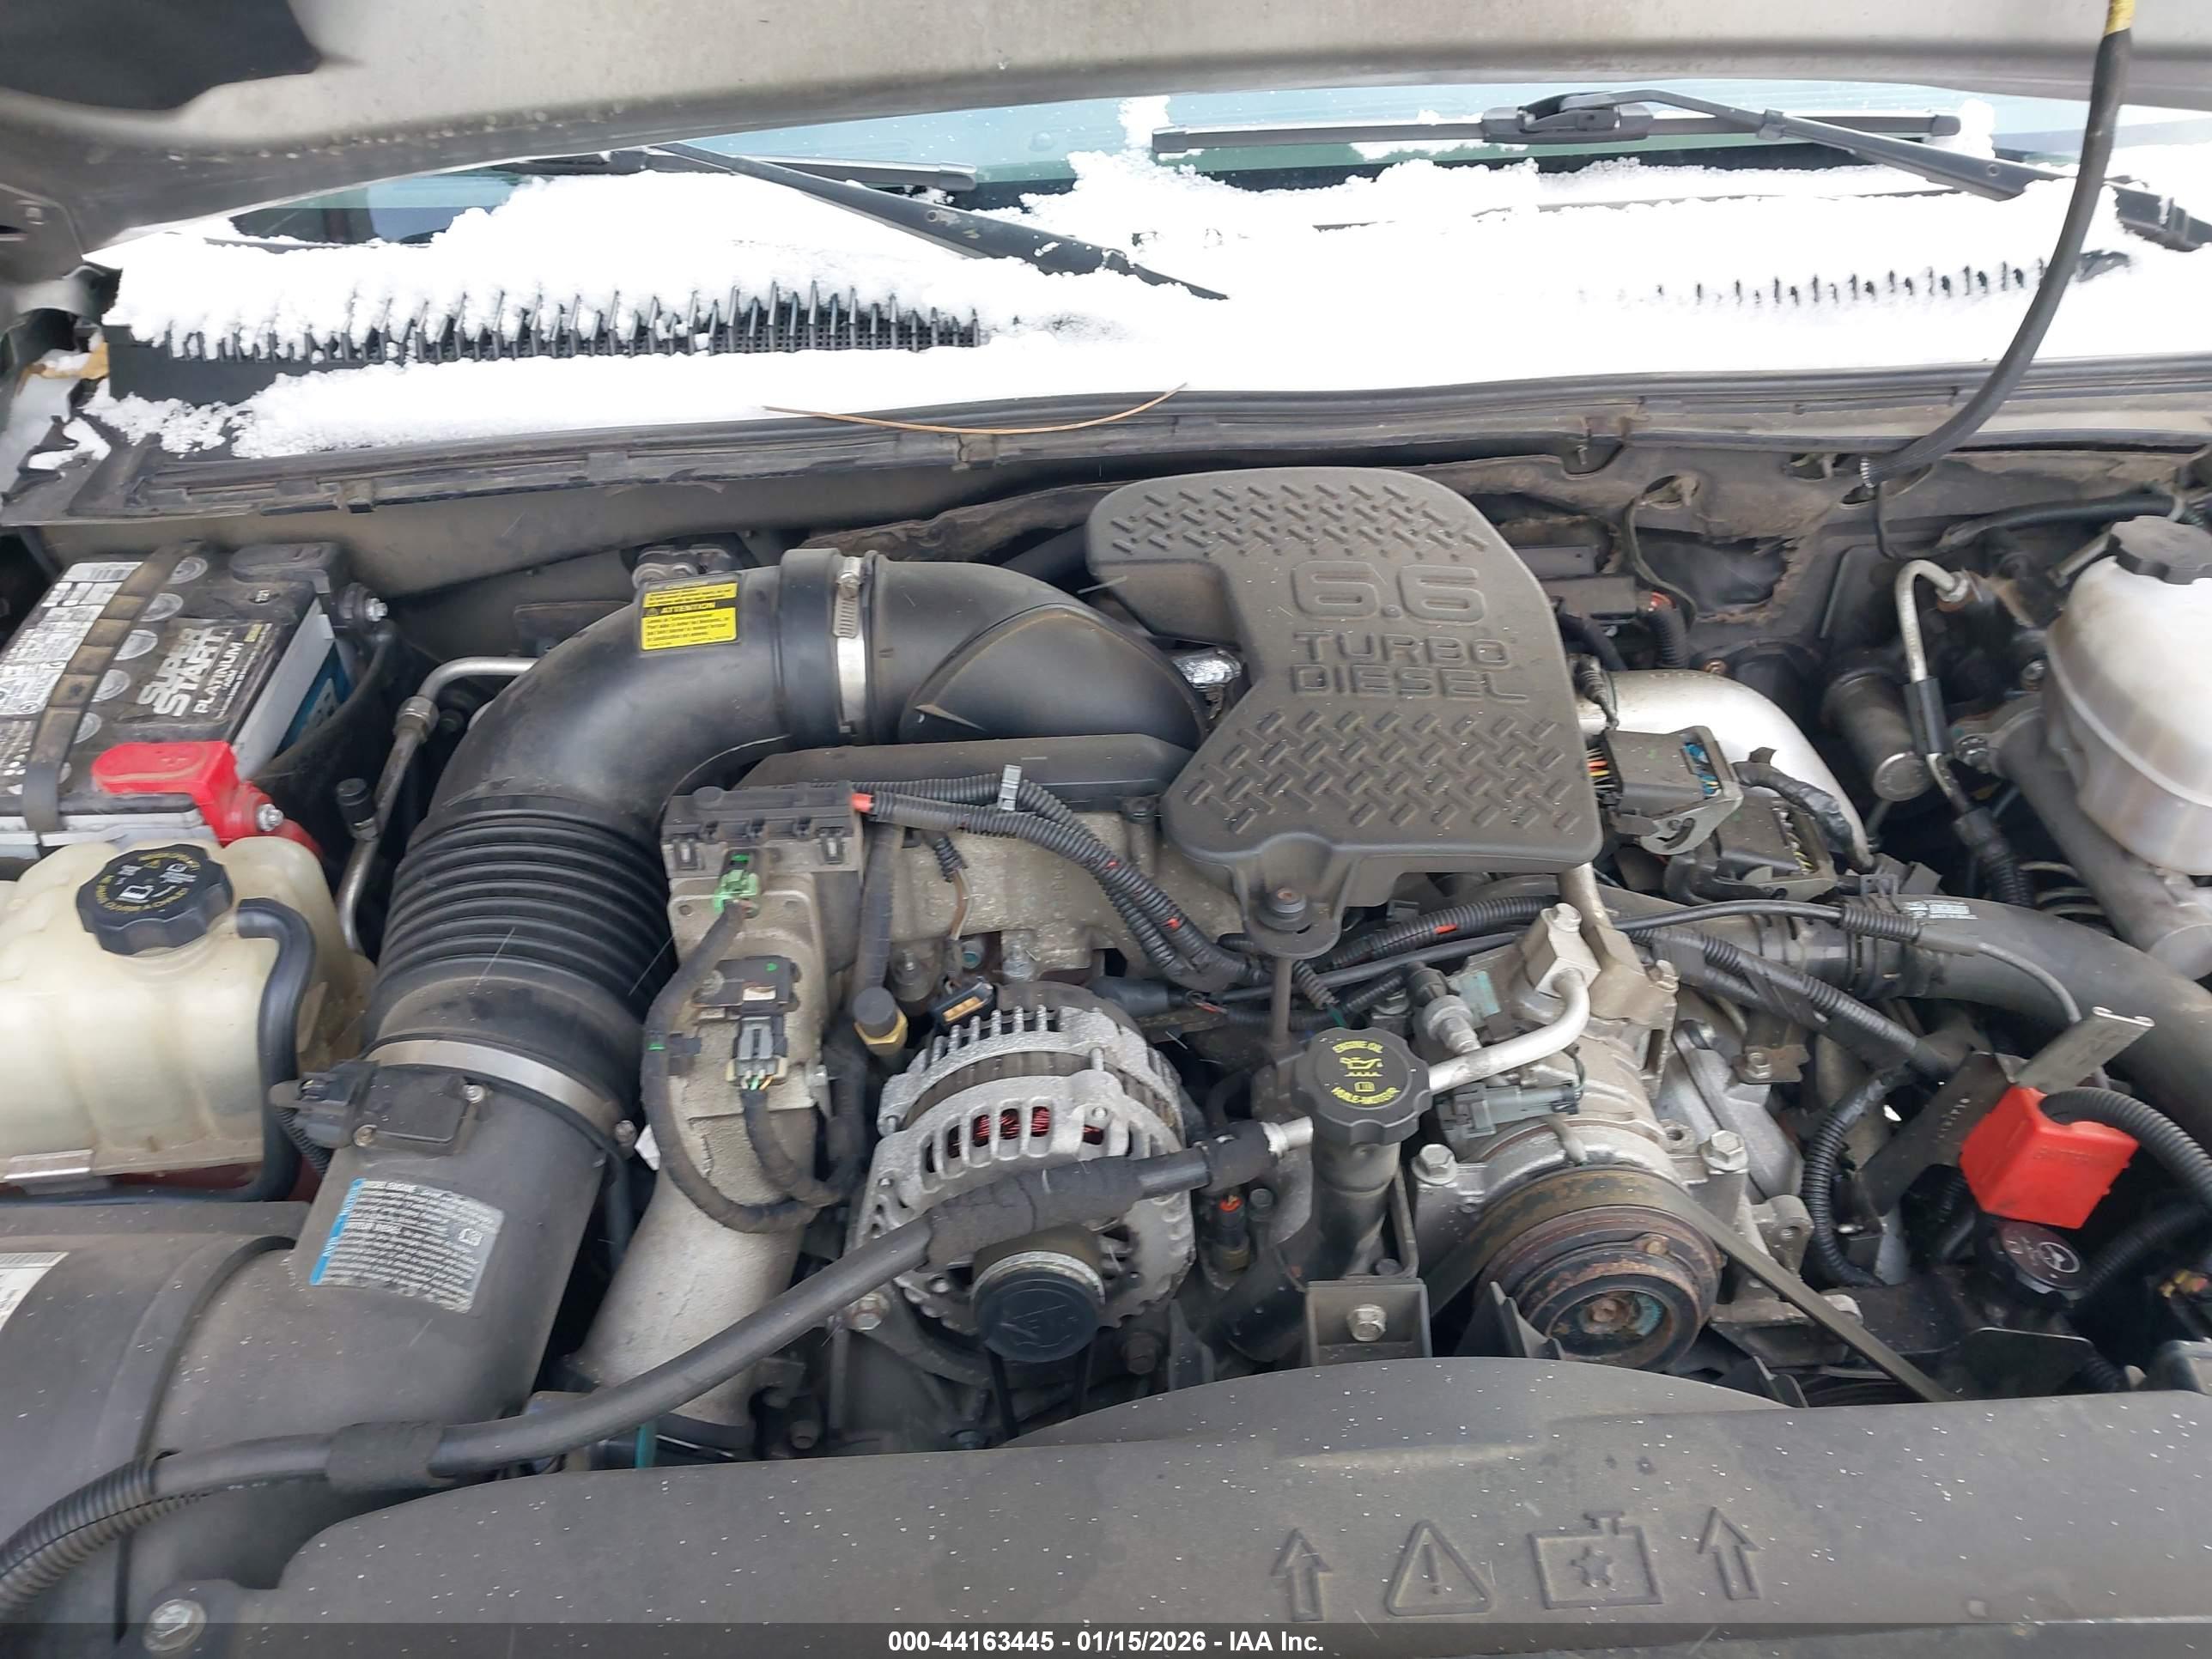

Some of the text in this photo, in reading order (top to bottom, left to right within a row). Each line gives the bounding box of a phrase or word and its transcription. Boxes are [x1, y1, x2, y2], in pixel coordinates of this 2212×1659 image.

[1291, 560, 1486, 627] 6.6
[137, 628, 207, 706] SUPER
[153, 628, 224, 716] START
[192, 641, 244, 714] PLATINUM
[1290, 664, 1531, 703] DIESEL
[1292, 631, 1511, 670] TURBO
